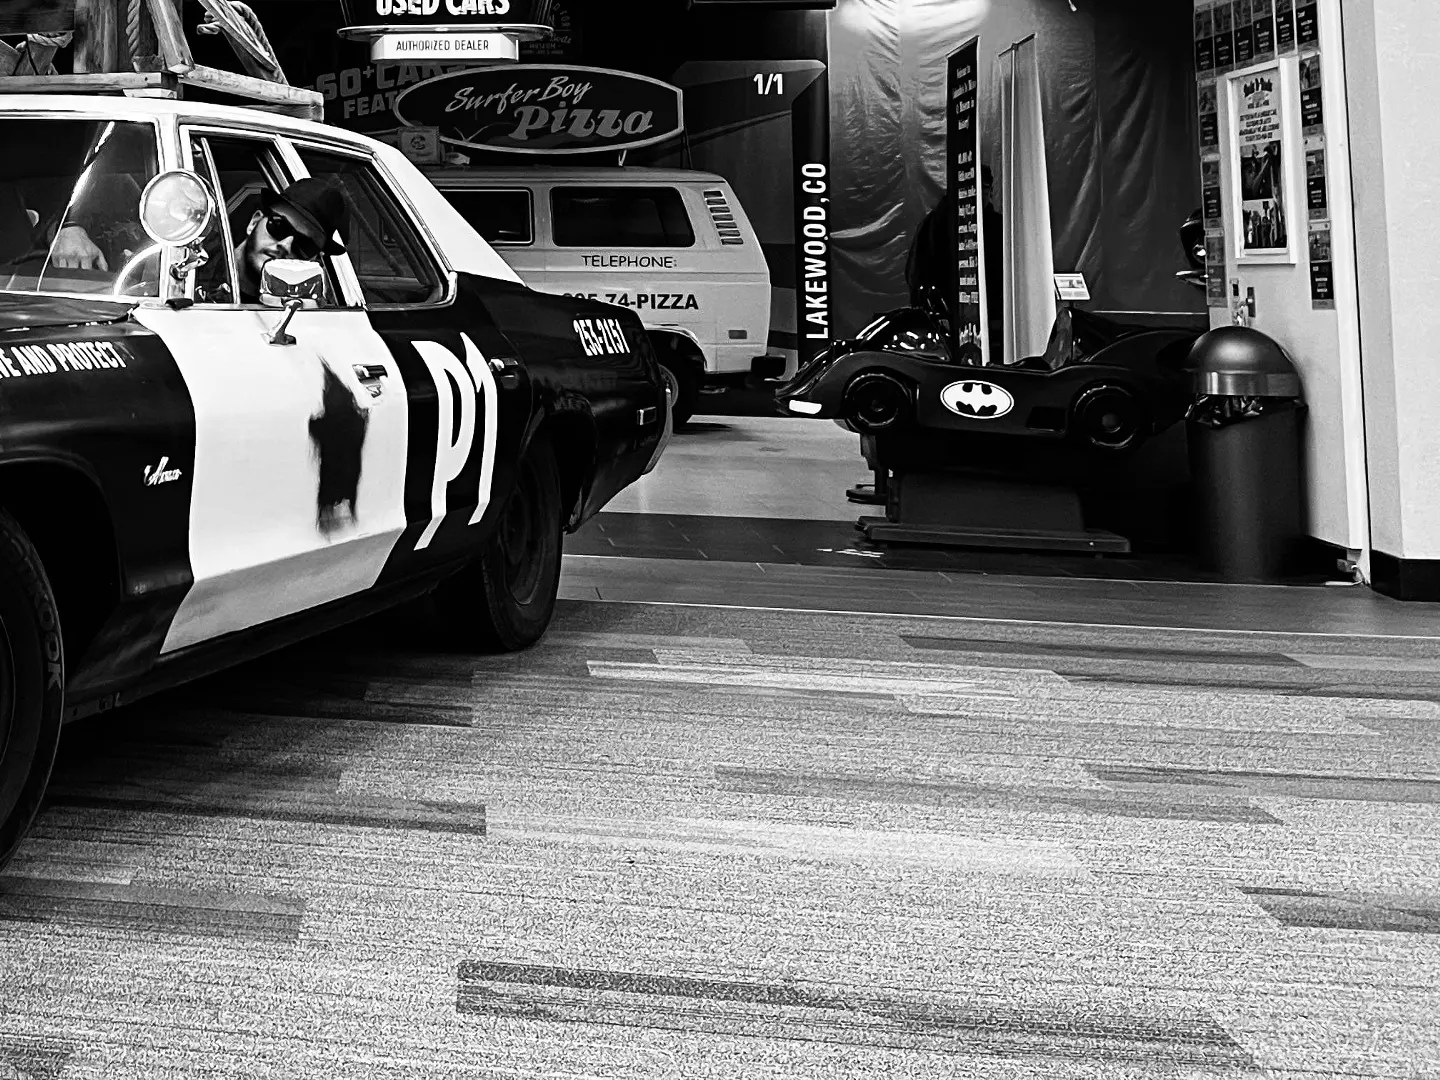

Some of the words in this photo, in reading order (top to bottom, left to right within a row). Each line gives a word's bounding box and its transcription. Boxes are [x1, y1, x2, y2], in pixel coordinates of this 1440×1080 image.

[396, 39, 450, 52] AUTHORIZED
[455, 39, 489, 51] DEALER
[444, 82, 541, 115] Surfer
[536, 75, 593, 105] Boy
[753, 73, 784, 95] 1/1
[572, 318, 631, 357] 253-2151
[10, 344, 58, 376] AND
[45, 340, 127, 372] PROTECT
[410, 331, 498, 551] P1
